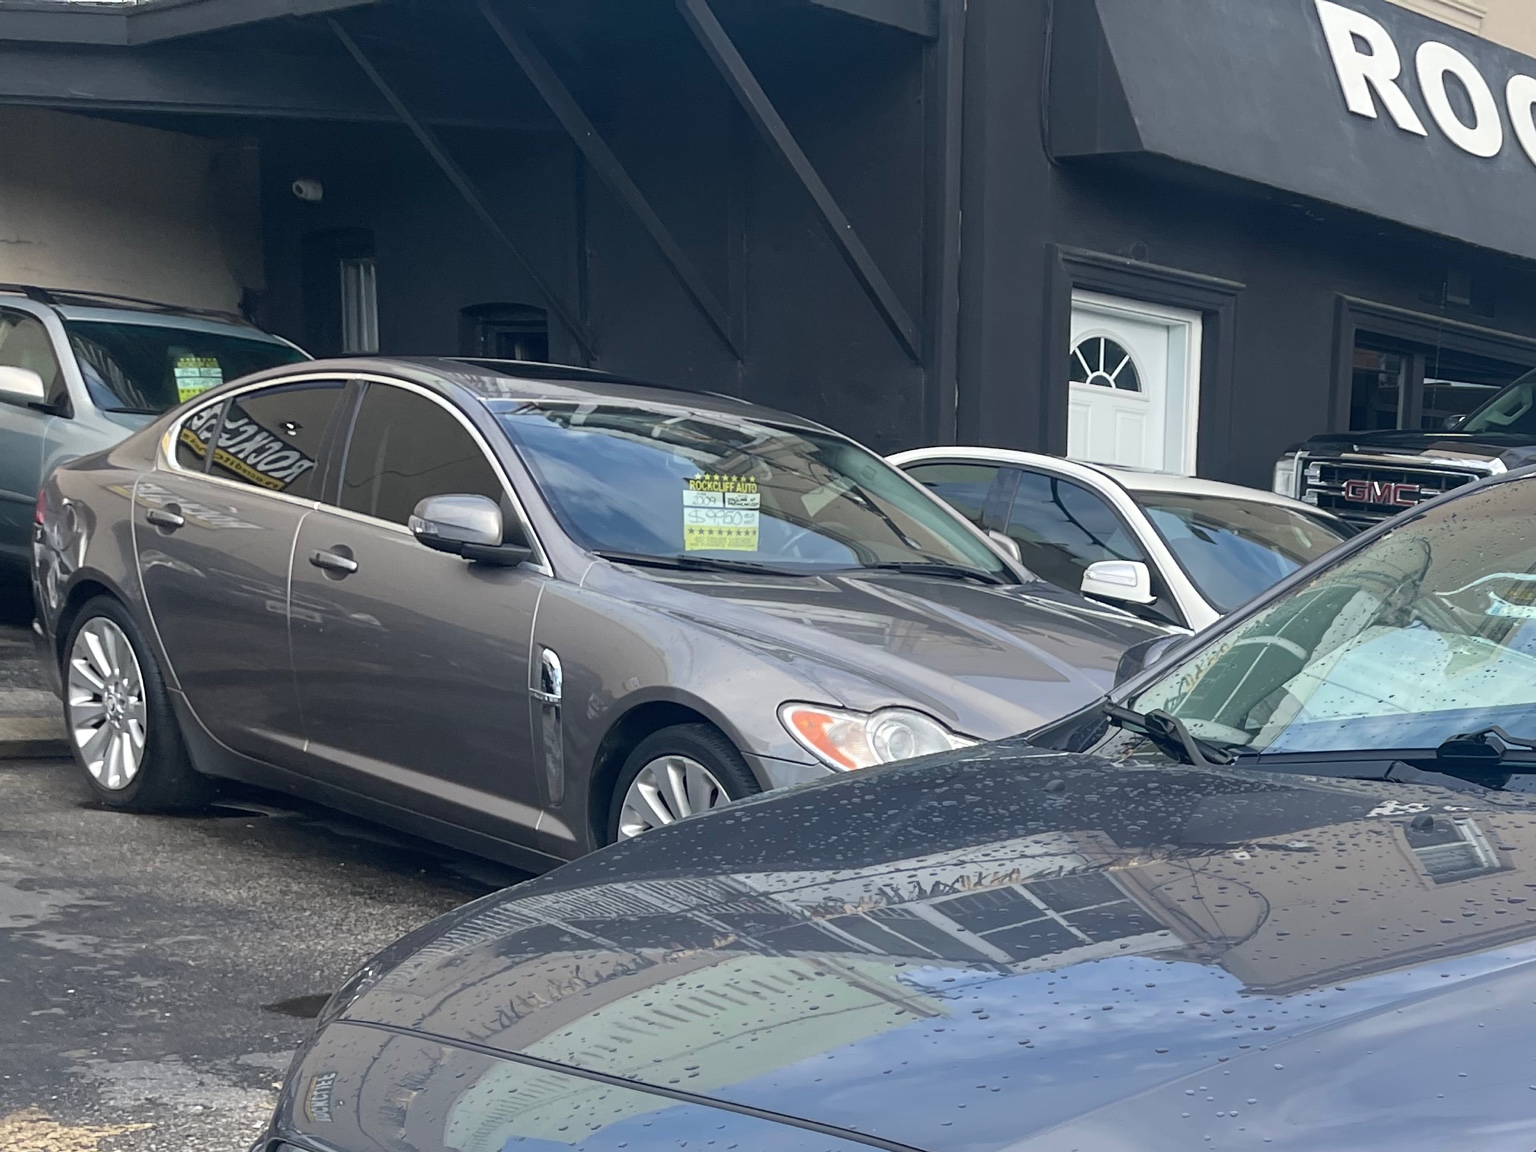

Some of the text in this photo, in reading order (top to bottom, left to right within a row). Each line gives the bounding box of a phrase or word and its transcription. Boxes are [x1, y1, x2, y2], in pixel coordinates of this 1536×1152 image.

[689, 480, 757, 493] ROCKCLIFF AUTO
[1345, 480, 1419, 506] GMC
